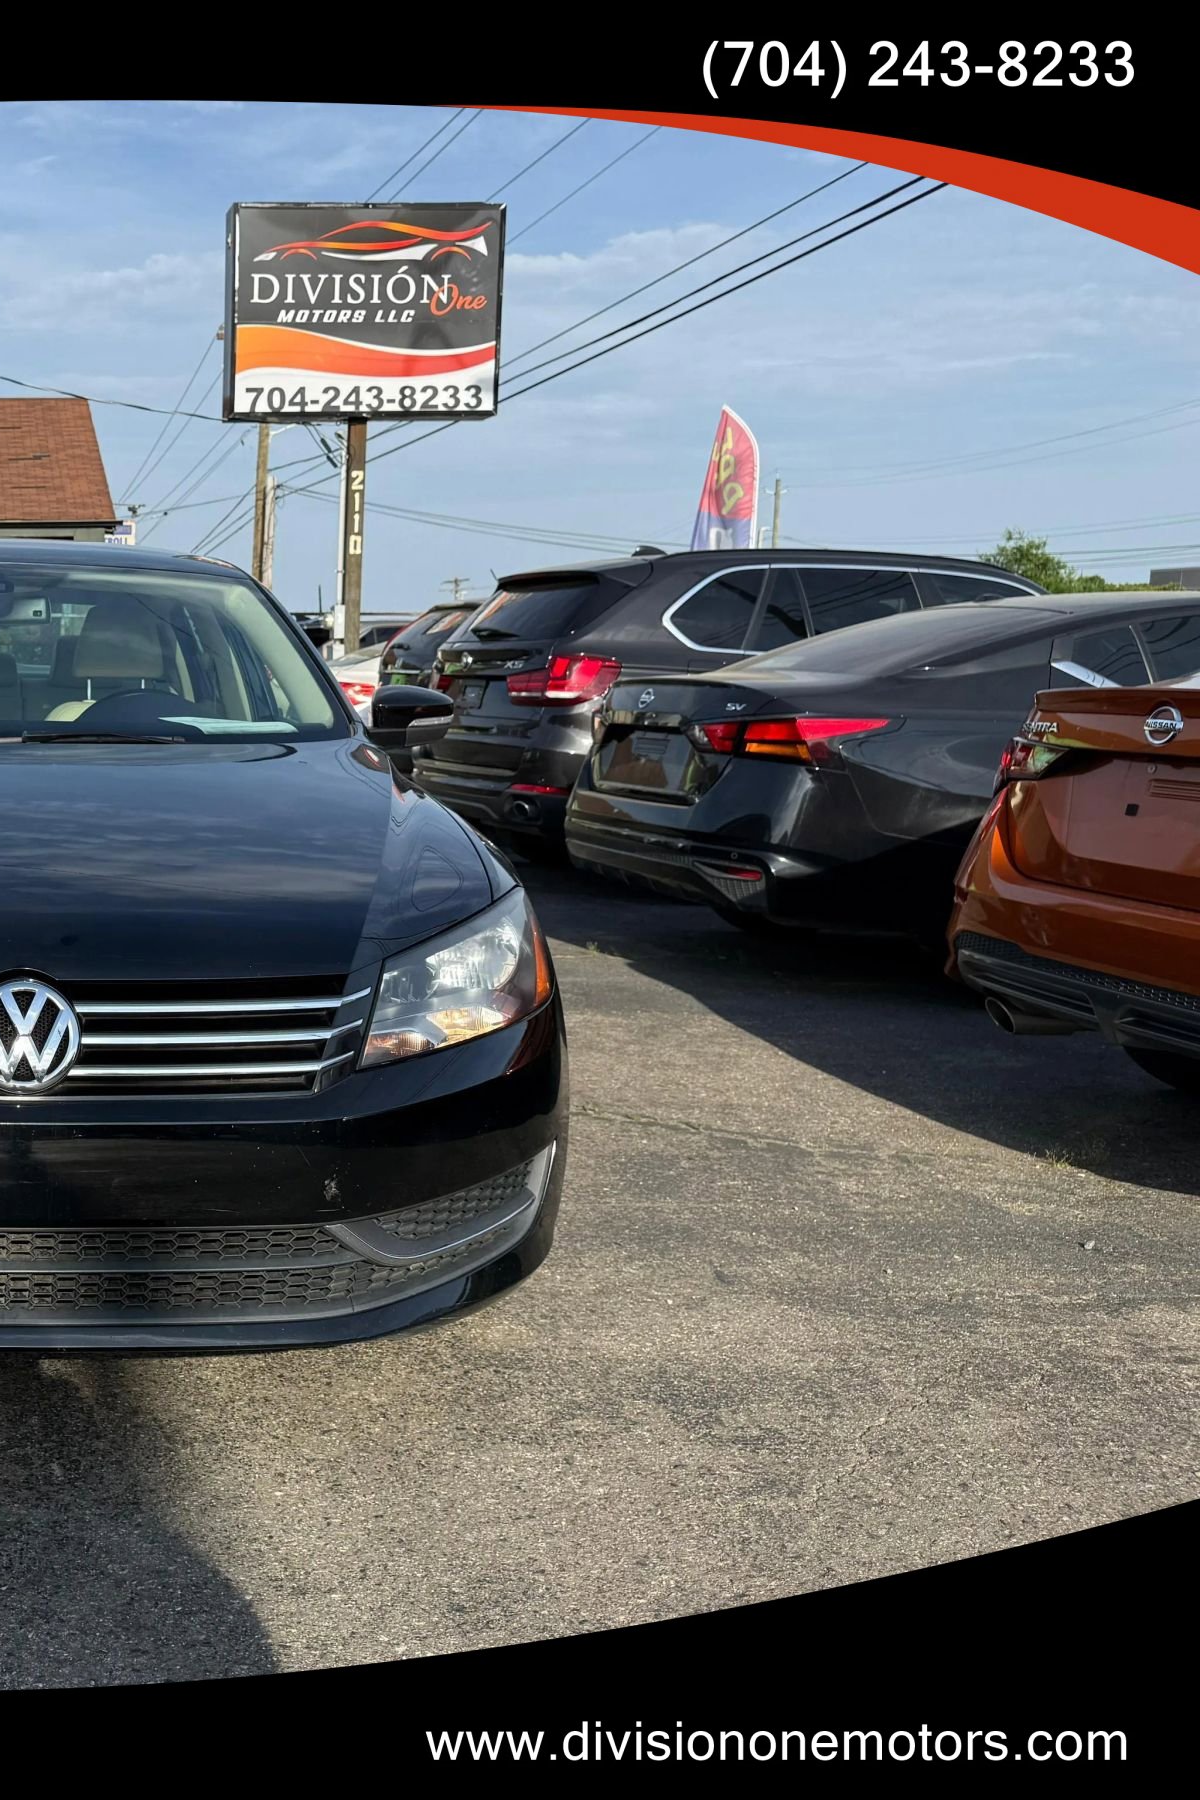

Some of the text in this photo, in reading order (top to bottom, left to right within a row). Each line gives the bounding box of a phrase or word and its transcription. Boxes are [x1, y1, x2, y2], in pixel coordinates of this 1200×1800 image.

[250, 266, 488, 317] DIVISIÓN One
[276, 308, 415, 324] MOTORS LLC
[245, 384, 483, 413] 704-243-8233
[348, 469, 365, 556] 2110
[725, 702, 747, 712] SV
[1144, 719, 1180, 732] NISSAN
